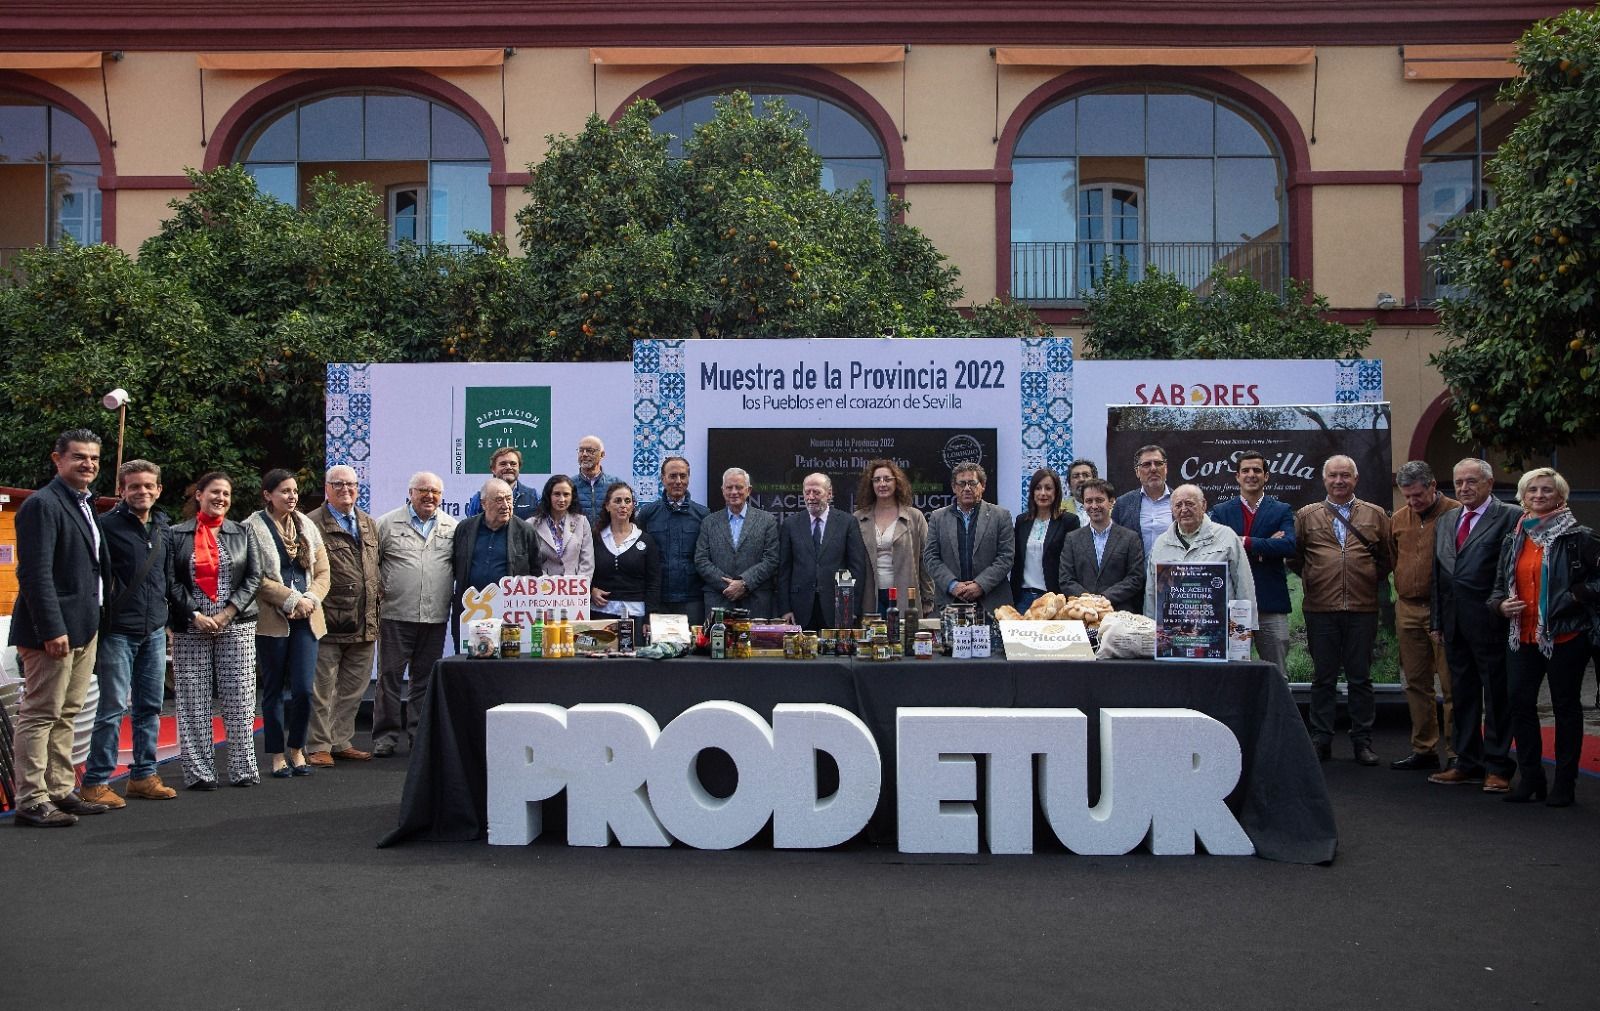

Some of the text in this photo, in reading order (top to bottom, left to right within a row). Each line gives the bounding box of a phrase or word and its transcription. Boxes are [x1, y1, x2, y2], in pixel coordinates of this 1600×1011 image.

[701, 360, 1005, 390] Muestra de la Provincia 2022
[743, 394, 962, 410] los Pueblos en el corazón de Sevilla
[1135, 383, 1260, 405] SABORES
[477, 438, 539, 449] SEVILLA
[455, 438, 463, 475] PRODETUR
[795, 454, 824, 468] Patio
[825, 456, 839, 468] de
[839, 456, 849, 468] la
[503, 578, 588, 596] SABORES
[528, 598, 575, 608] PROVINCIA
[577, 598, 588, 607] DE
